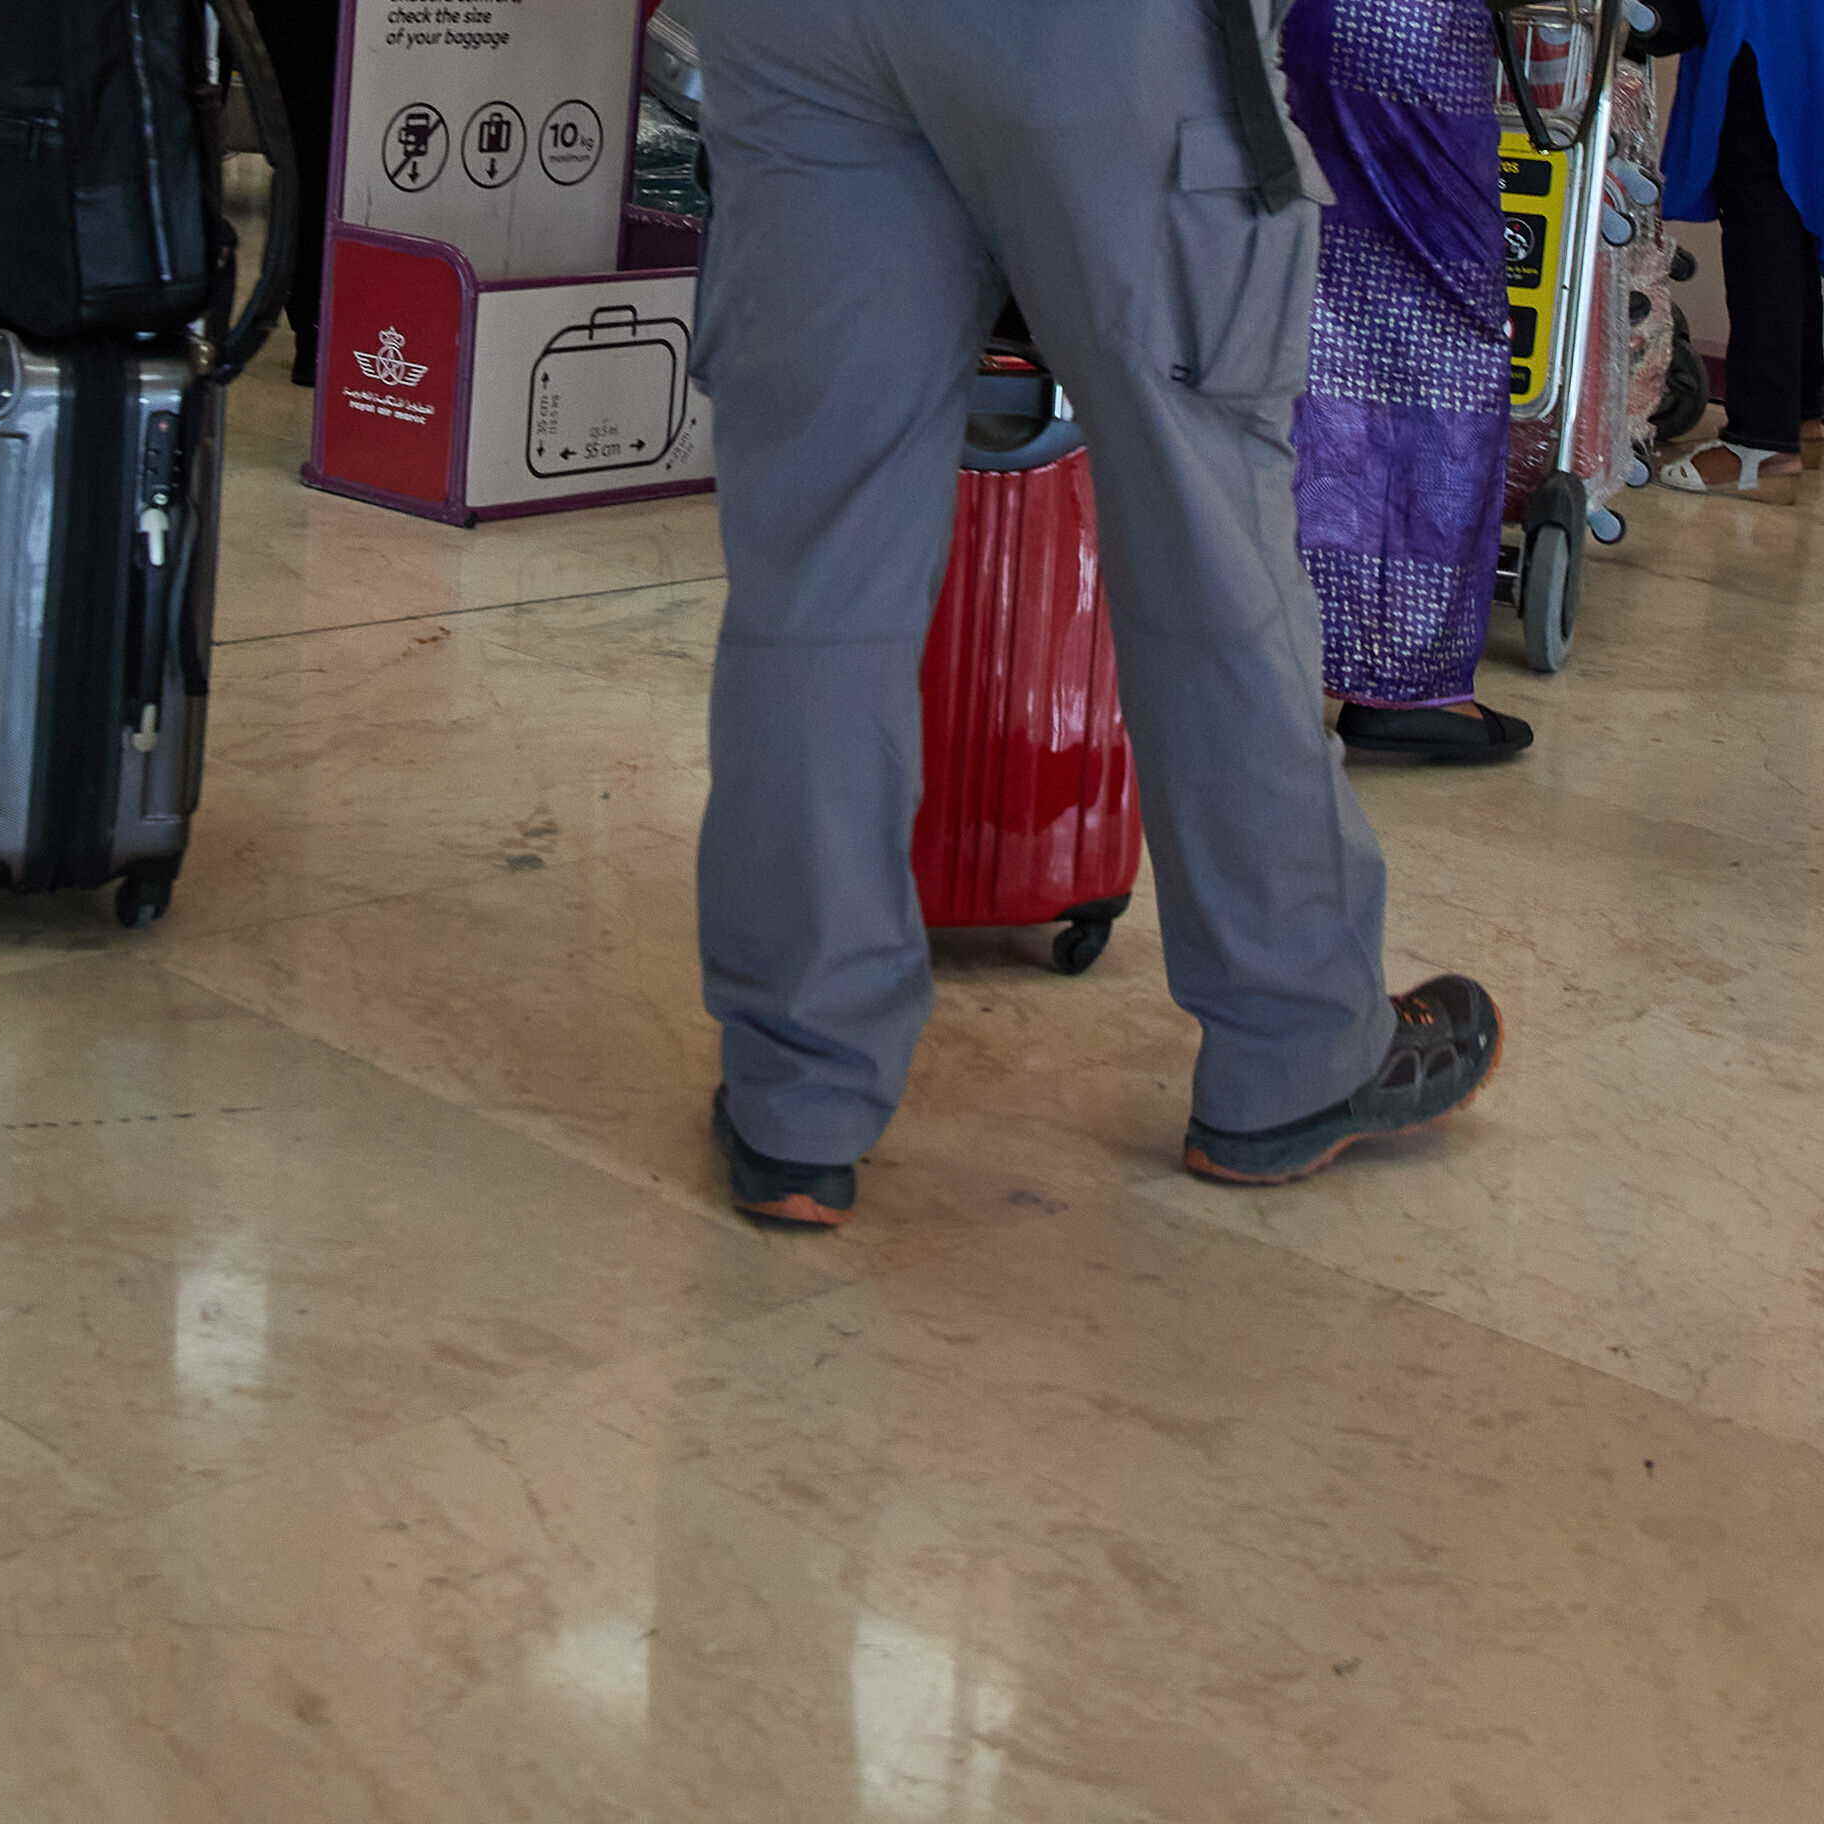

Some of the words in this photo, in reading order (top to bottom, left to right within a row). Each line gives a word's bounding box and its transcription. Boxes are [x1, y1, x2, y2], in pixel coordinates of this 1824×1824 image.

[387, 6, 431, 24] check
[435, 6, 461, 24] the
[463, 6, 492, 24] size
[386, 27, 405, 45] of
[406, 31, 442, 51] your
[444, 27, 510, 50] baggage
[549, 122, 578, 148] 10
[349, 399, 375, 413] royal
[394, 410, 427, 425] maroc
[601, 443, 622, 458] cm
